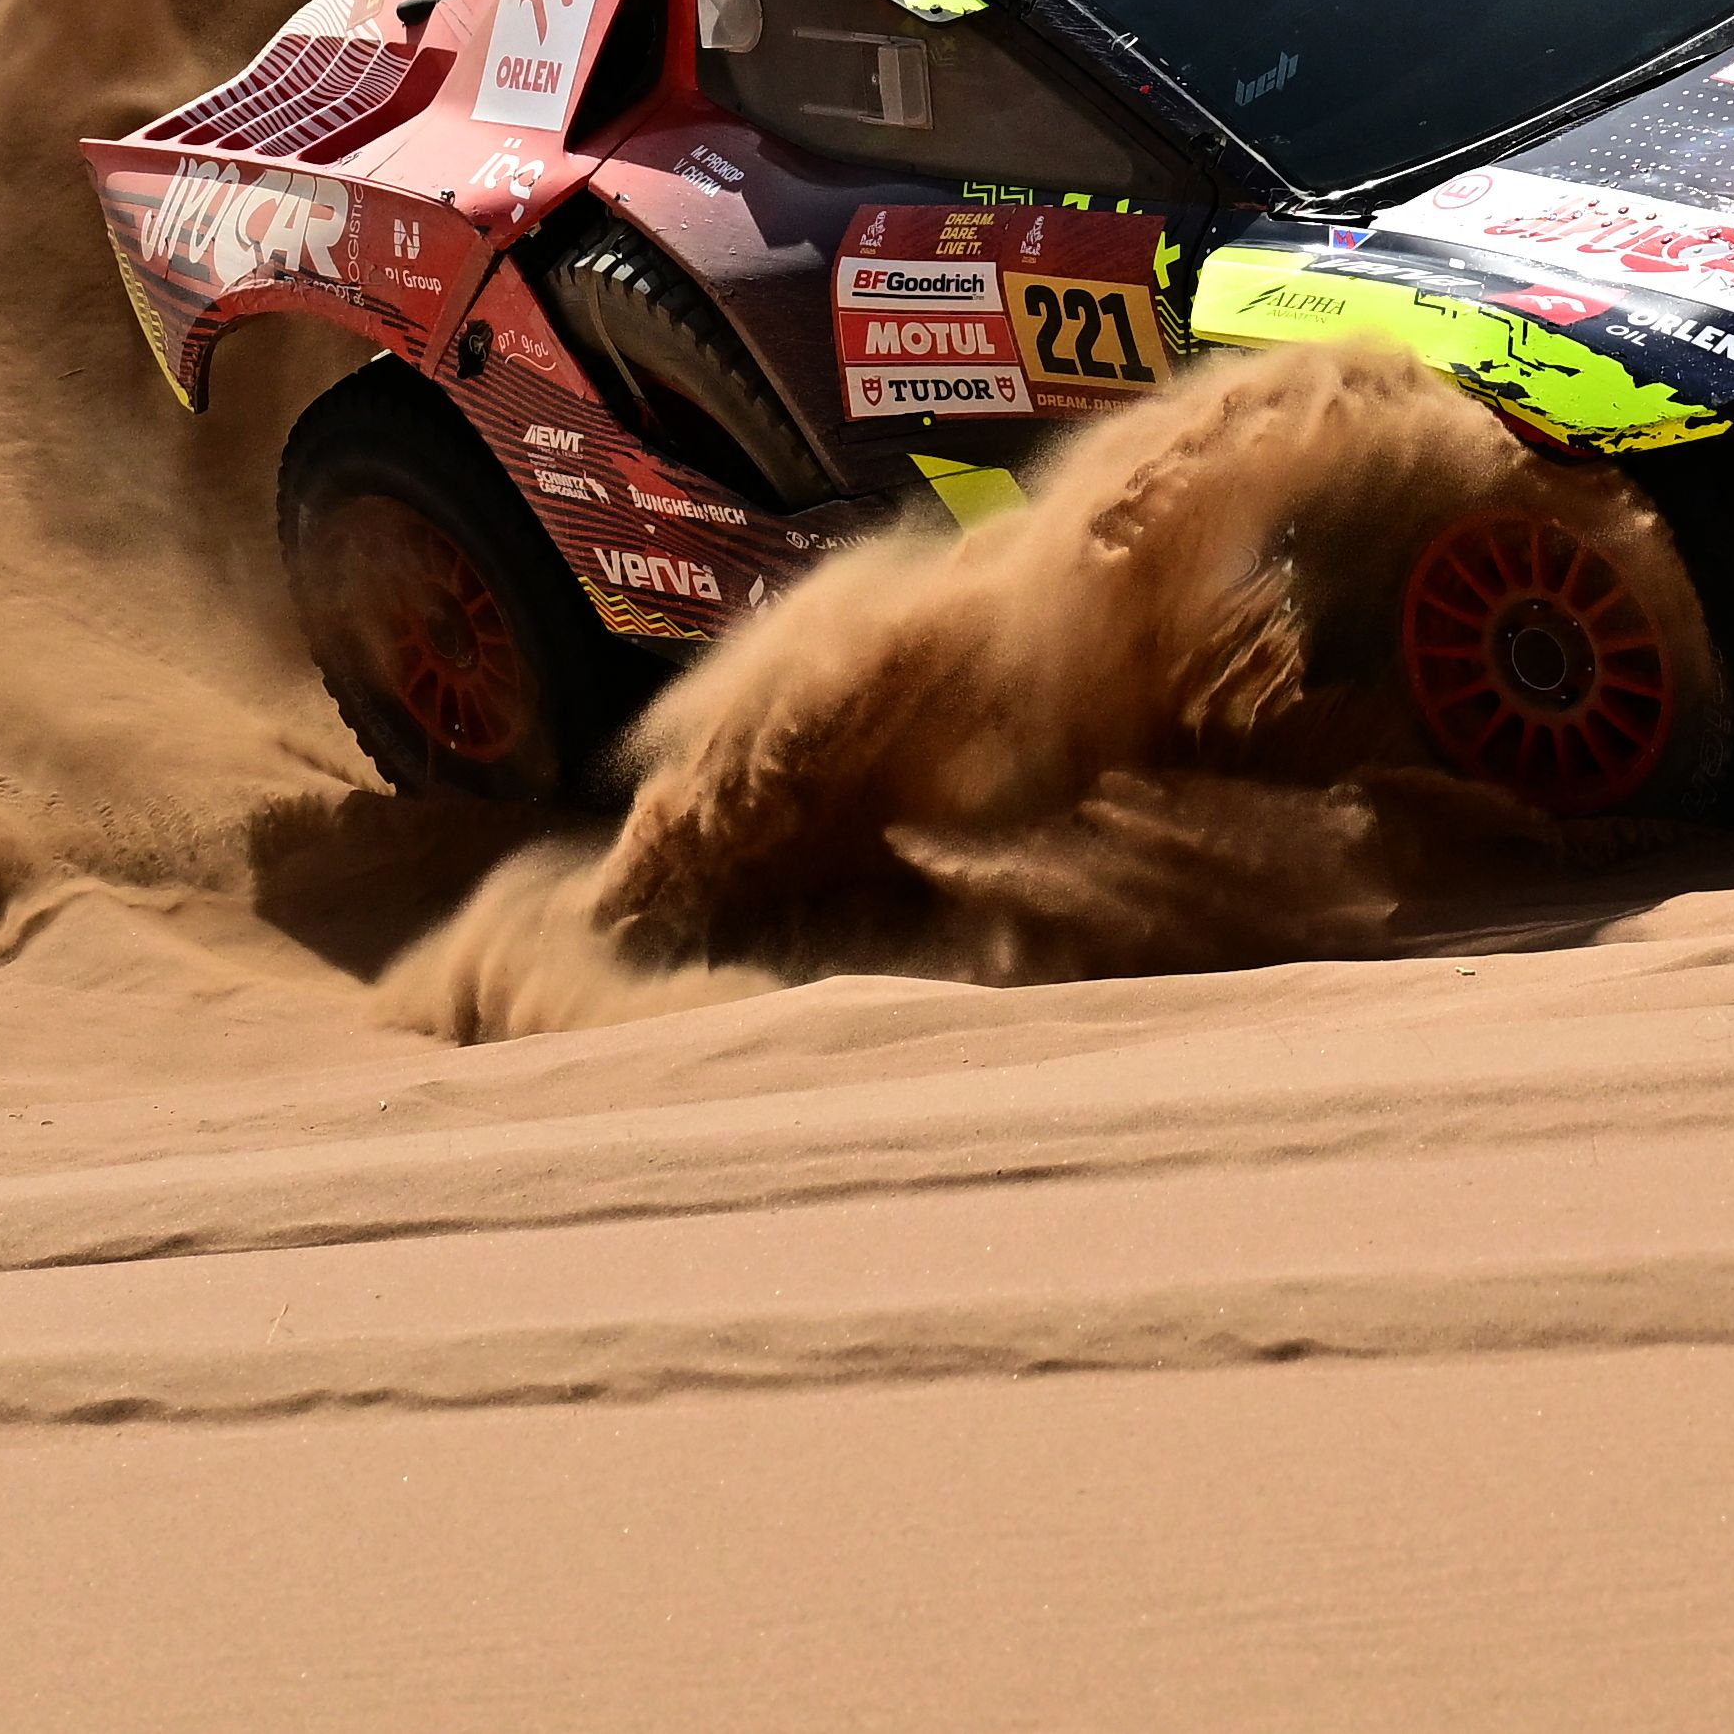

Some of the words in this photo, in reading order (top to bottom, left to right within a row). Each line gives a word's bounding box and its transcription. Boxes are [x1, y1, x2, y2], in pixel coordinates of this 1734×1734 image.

[495, 55, 563, 95] ORLEN
[700, 152, 745, 183] PROKOP
[945, 213, 994, 226] DREAM.
[940, 227, 978, 240] DARE.
[936, 241, 966, 255] LIVE
[966, 241, 982, 255] IT.
[402, 269, 442, 296] Group
[853, 269, 985, 293] BFGoodrich
[1268, 292, 1346, 316] ALPHA
[865, 321, 995, 355] MOTUL
[1024, 284, 1156, 383] 221
[1605, 325, 1648, 348] OIL
[888, 379, 995, 402] TUDOR
[1036, 393, 1092, 410] DREAM.
